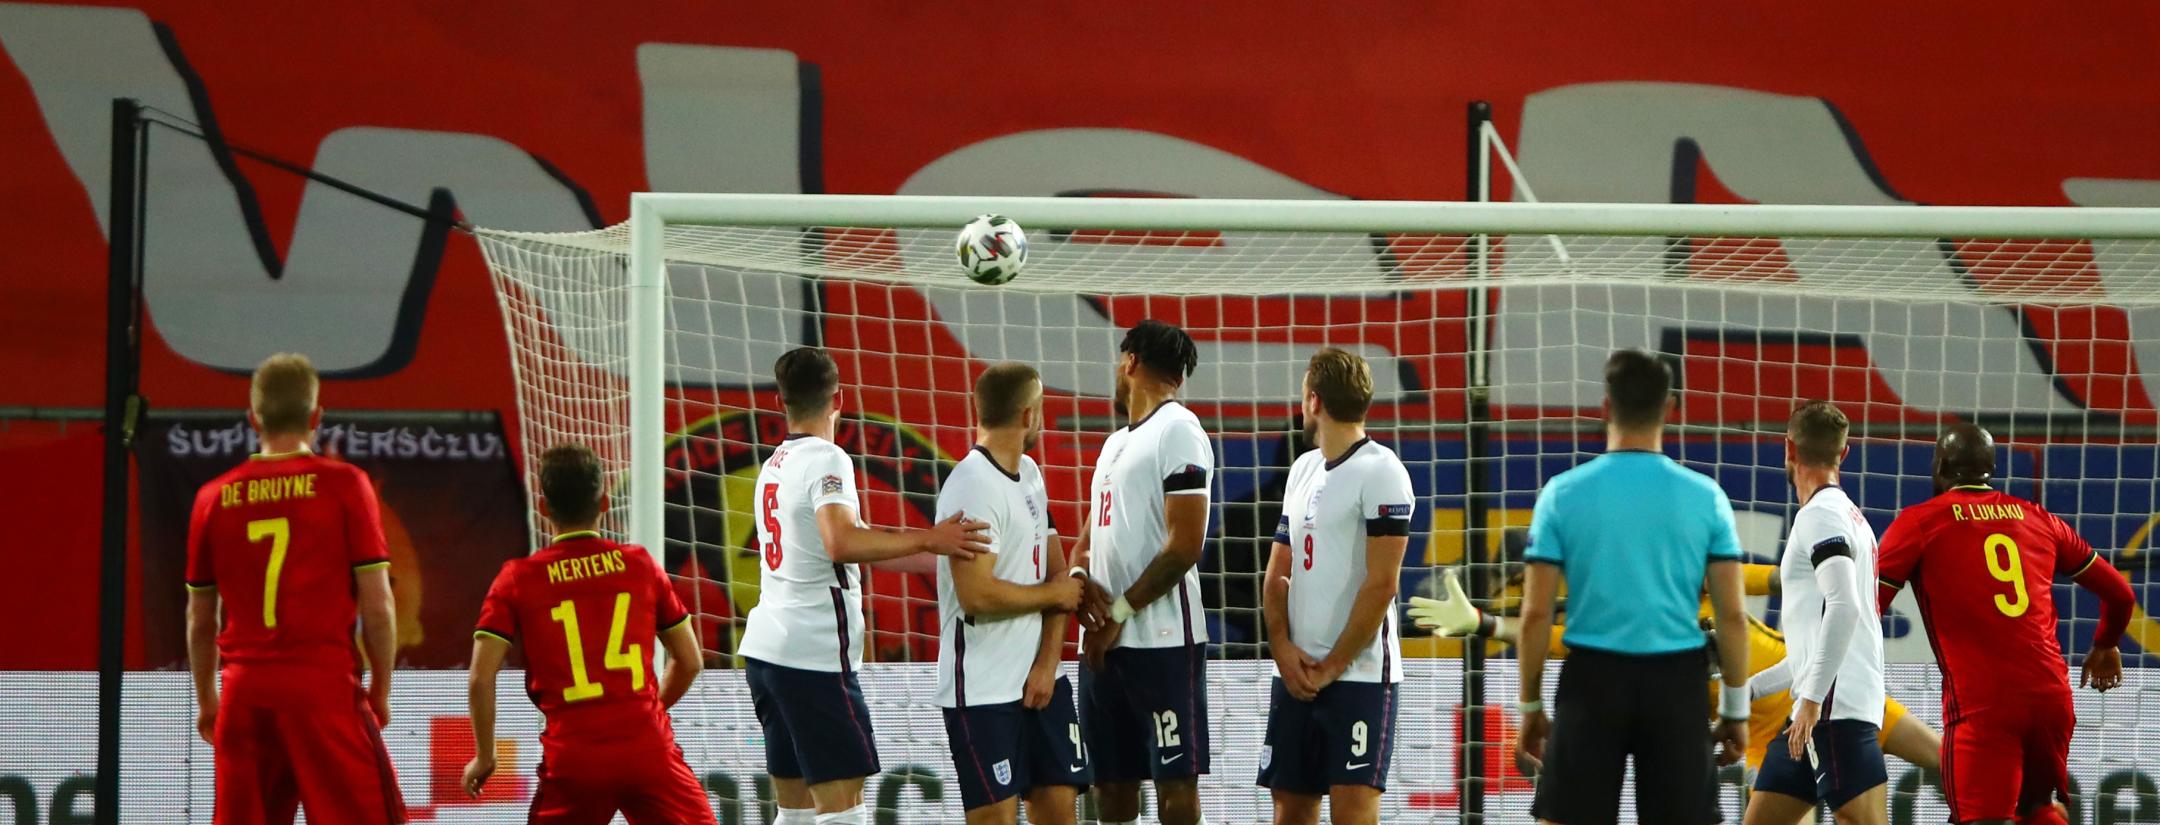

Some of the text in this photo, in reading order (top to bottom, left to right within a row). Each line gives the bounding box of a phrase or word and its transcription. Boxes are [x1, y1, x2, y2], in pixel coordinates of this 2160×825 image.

[221, 473, 318, 508] DE BRUYNE
[1098, 489, 1113, 528] 12
[763, 482, 784, 572] 5
[1951, 503, 2025, 521] R. LUKAKU
[546, 549, 627, 585] MERTENS
[1032, 543, 1041, 580] 4
[1303, 533, 1314, 571] 9
[247, 516, 291, 629] 7
[1983, 532, 2030, 618] 9
[550, 591, 646, 703] 14
[1068, 722, 1083, 760] 4
[1152, 708, 1182, 748] 12
[1350, 719, 1369, 757] 9
